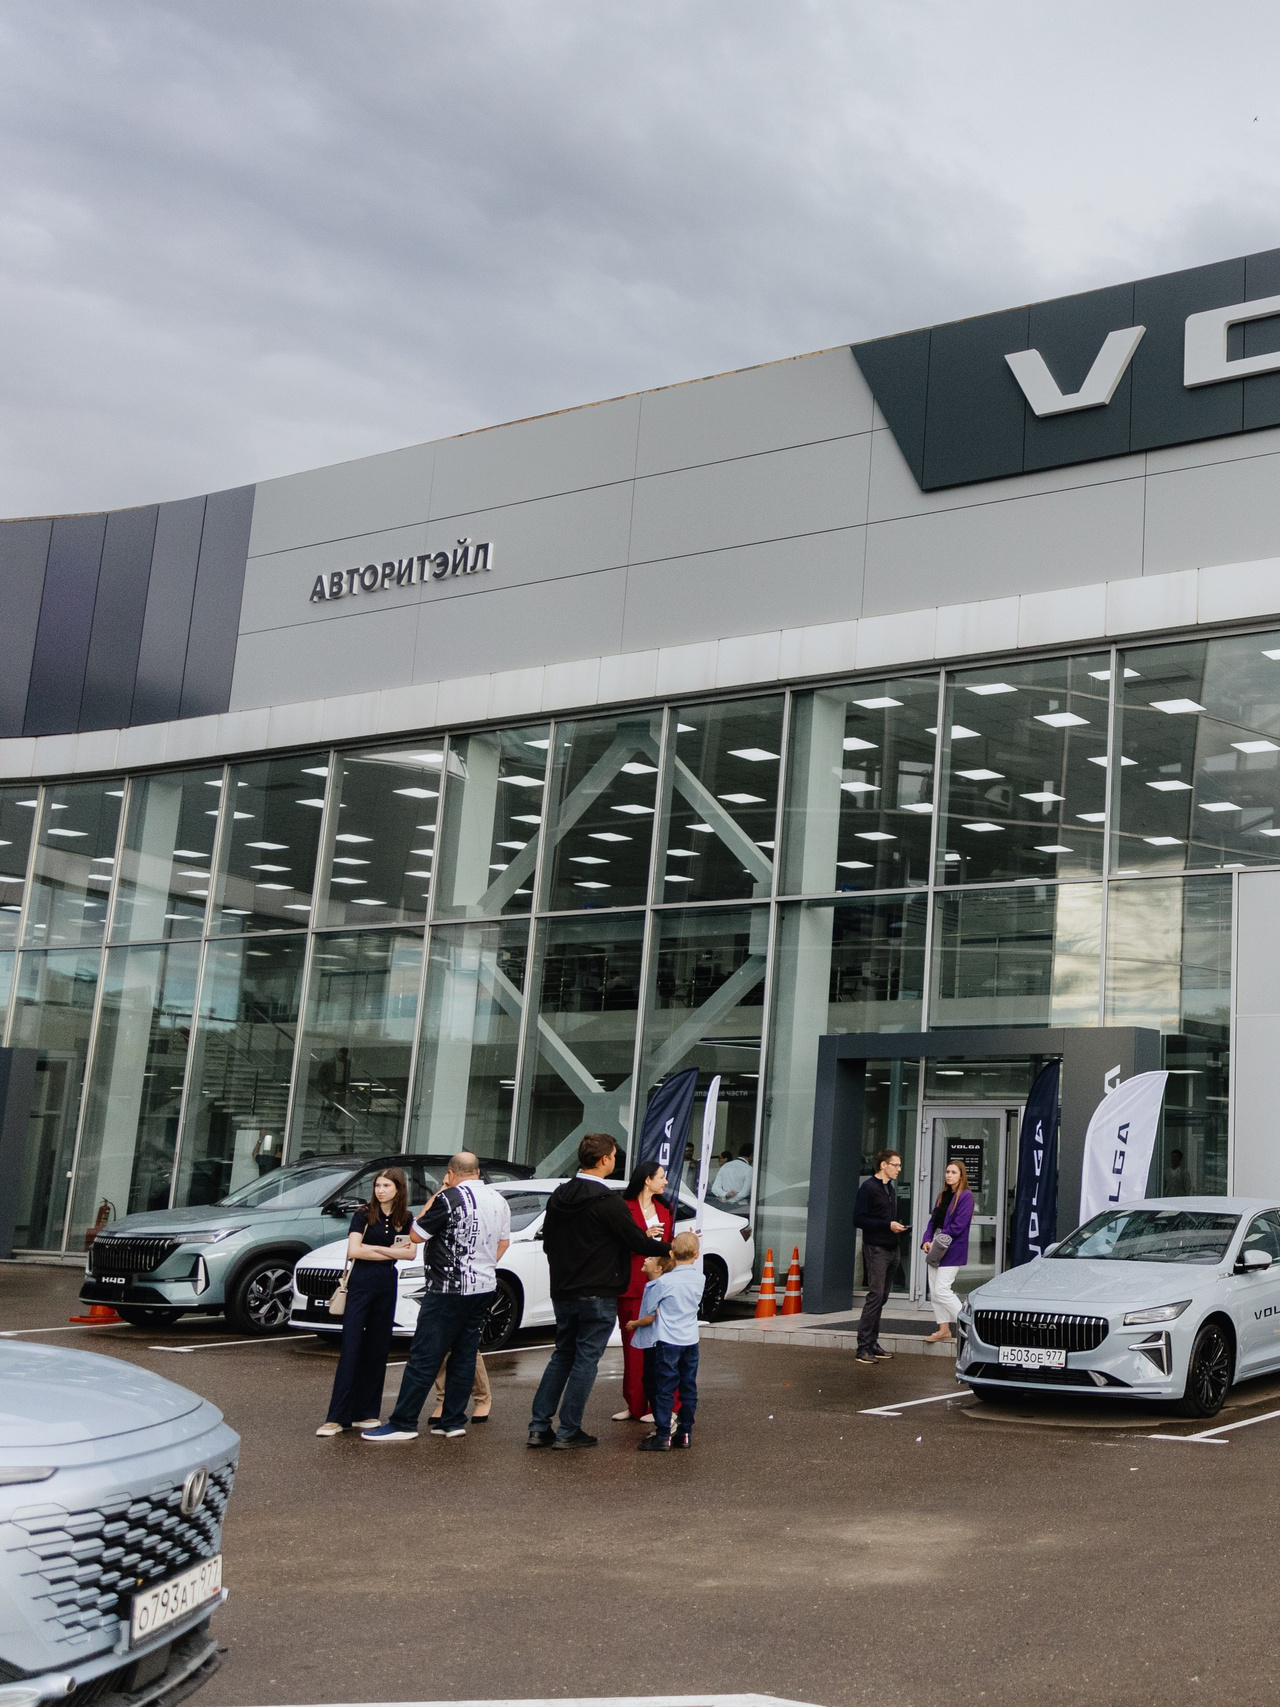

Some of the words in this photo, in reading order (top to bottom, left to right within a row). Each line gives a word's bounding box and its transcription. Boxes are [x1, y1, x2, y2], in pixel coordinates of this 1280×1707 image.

[309, 538, 493, 603] АВТОРИТЭЙЛ
[659, 1117, 674, 1178] GA
[101, 1276, 126, 1284] K40
[1012, 1321, 1058, 1330] VOLGA
[1045, 1351, 1063, 1361] 977
[200, 1559, 219, 1590] 977
